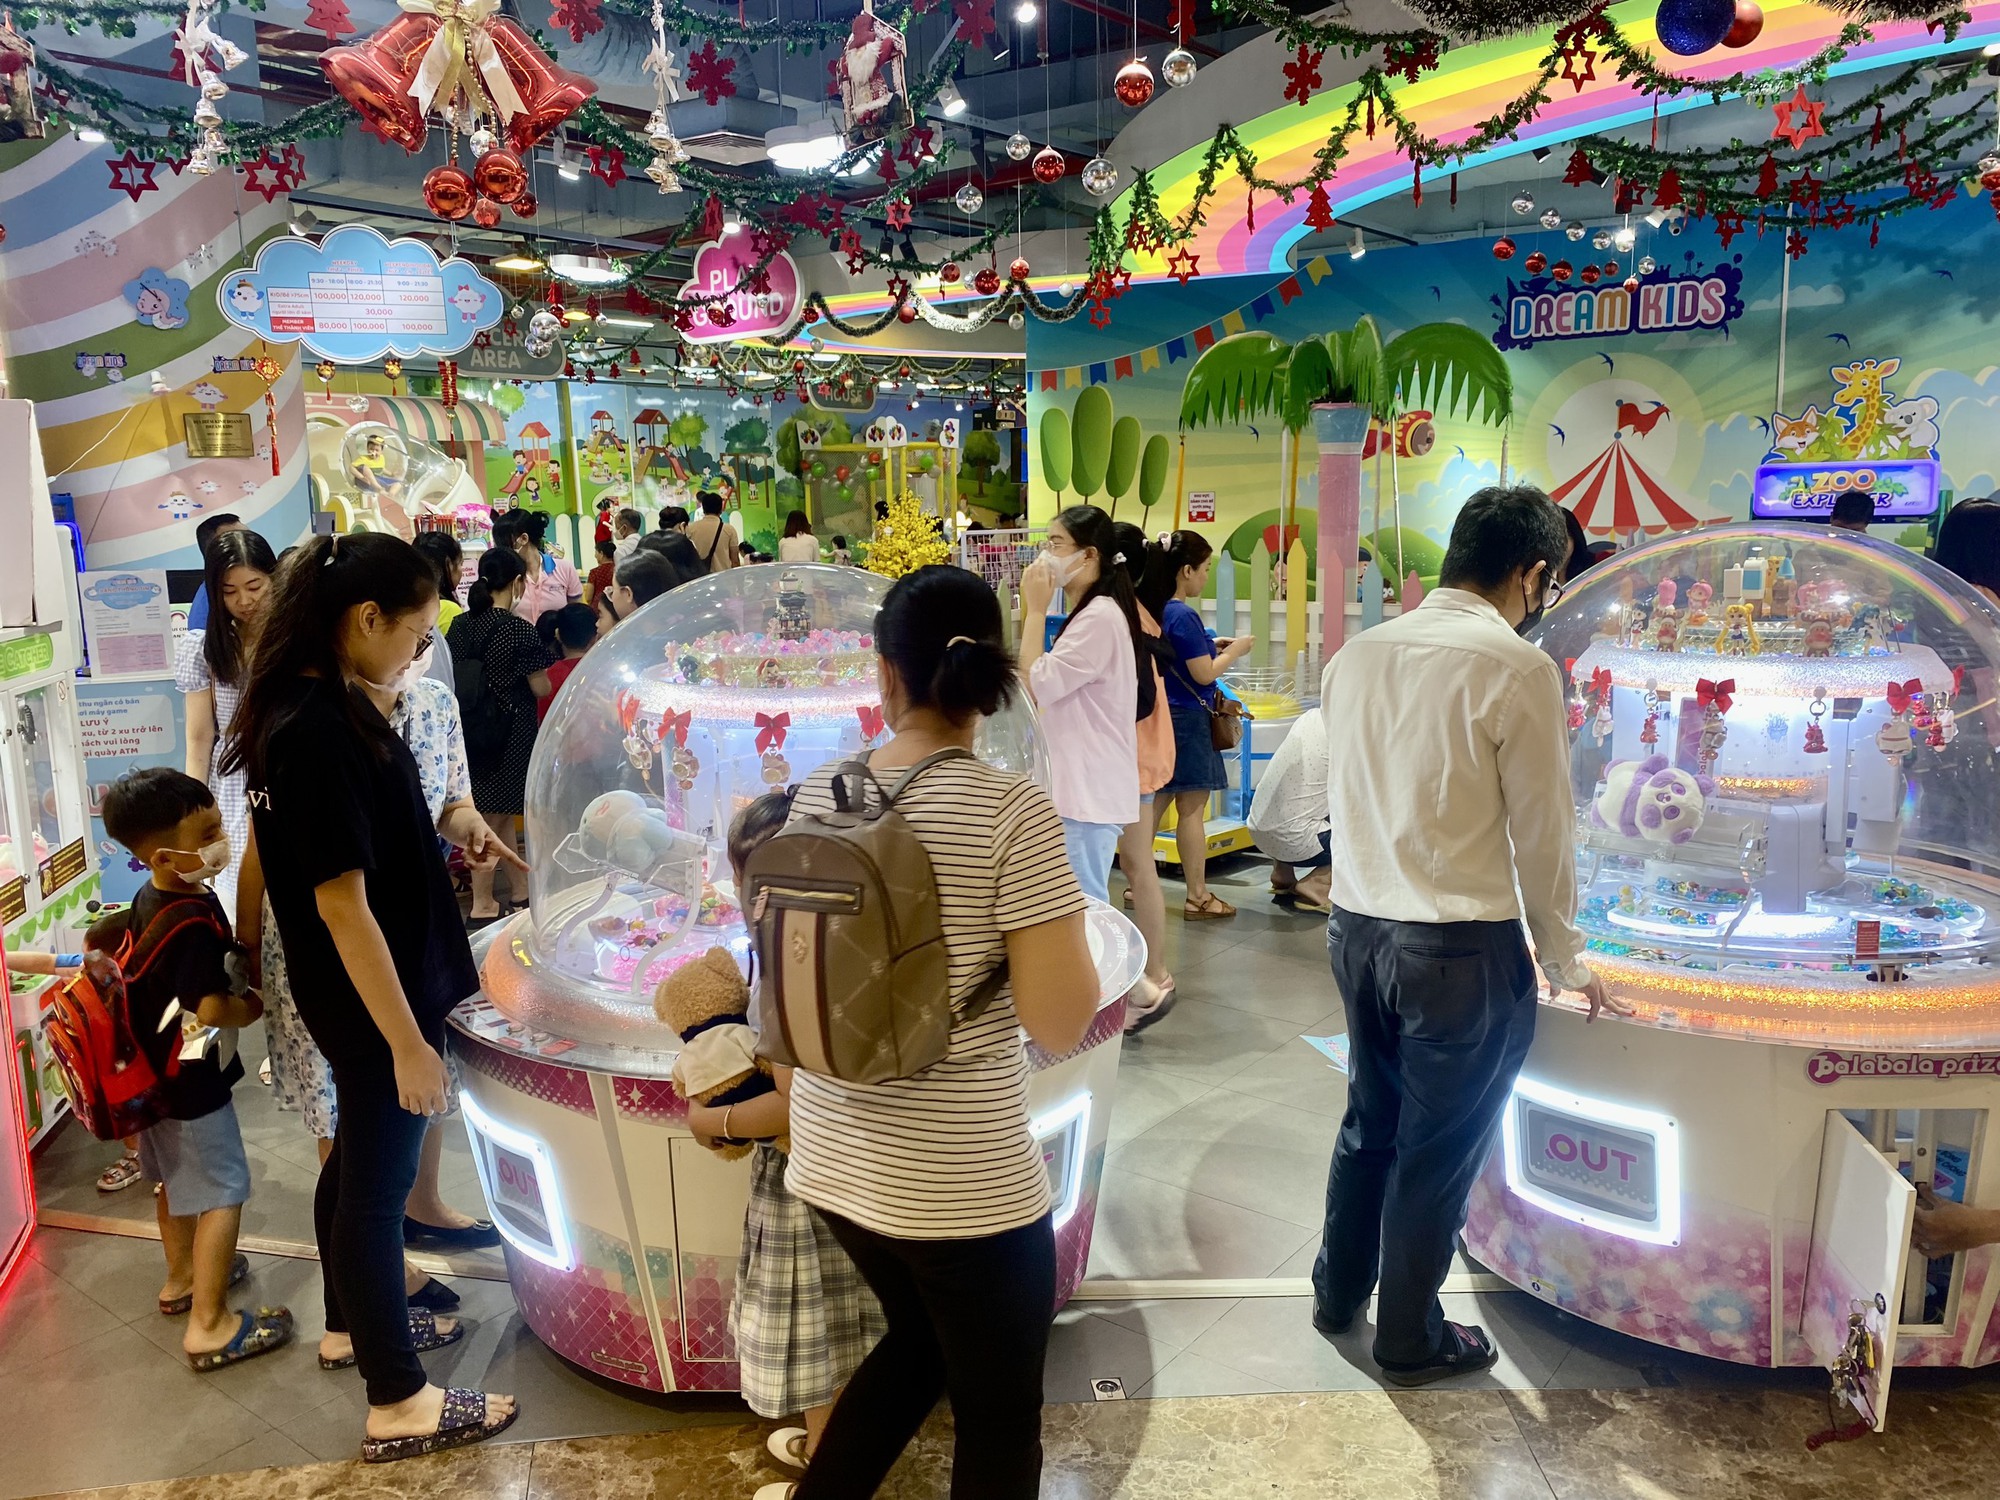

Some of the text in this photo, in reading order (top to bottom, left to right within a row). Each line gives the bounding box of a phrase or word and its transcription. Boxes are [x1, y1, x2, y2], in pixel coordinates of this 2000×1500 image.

[709, 265, 754, 294] PLA
[314, 293, 347, 301] 100,000
[350, 293, 382, 302] 120,000
[365, 308, 393, 316] 30,000
[692, 292, 784, 327] GOUND
[1511, 278, 1726, 338] DREAM KIDS
[319, 322, 347, 330] 80,000
[402, 323, 433, 331] 100,000
[104, 355, 124, 367] KIDS
[470, 348, 521, 369] AREA
[1811, 469, 1878, 493] ZOO
[1791, 492, 1893, 509] EXPLER
[94, 699, 113, 707] ngân
[88, 708, 105, 716] máy
[80, 718, 100, 727] LƯU
[98, 728, 108, 736] từ
[132, 725, 147, 734] trở
[148, 725, 163, 733] lên
[103, 738, 117, 746] vui
[120, 737, 140, 745] lòng
[120, 747, 138, 755] ATM
[1814, 1053, 1934, 1079] balabala
[1545, 1133, 1637, 1181] OUT
[498, 1156, 540, 1204] OUT
